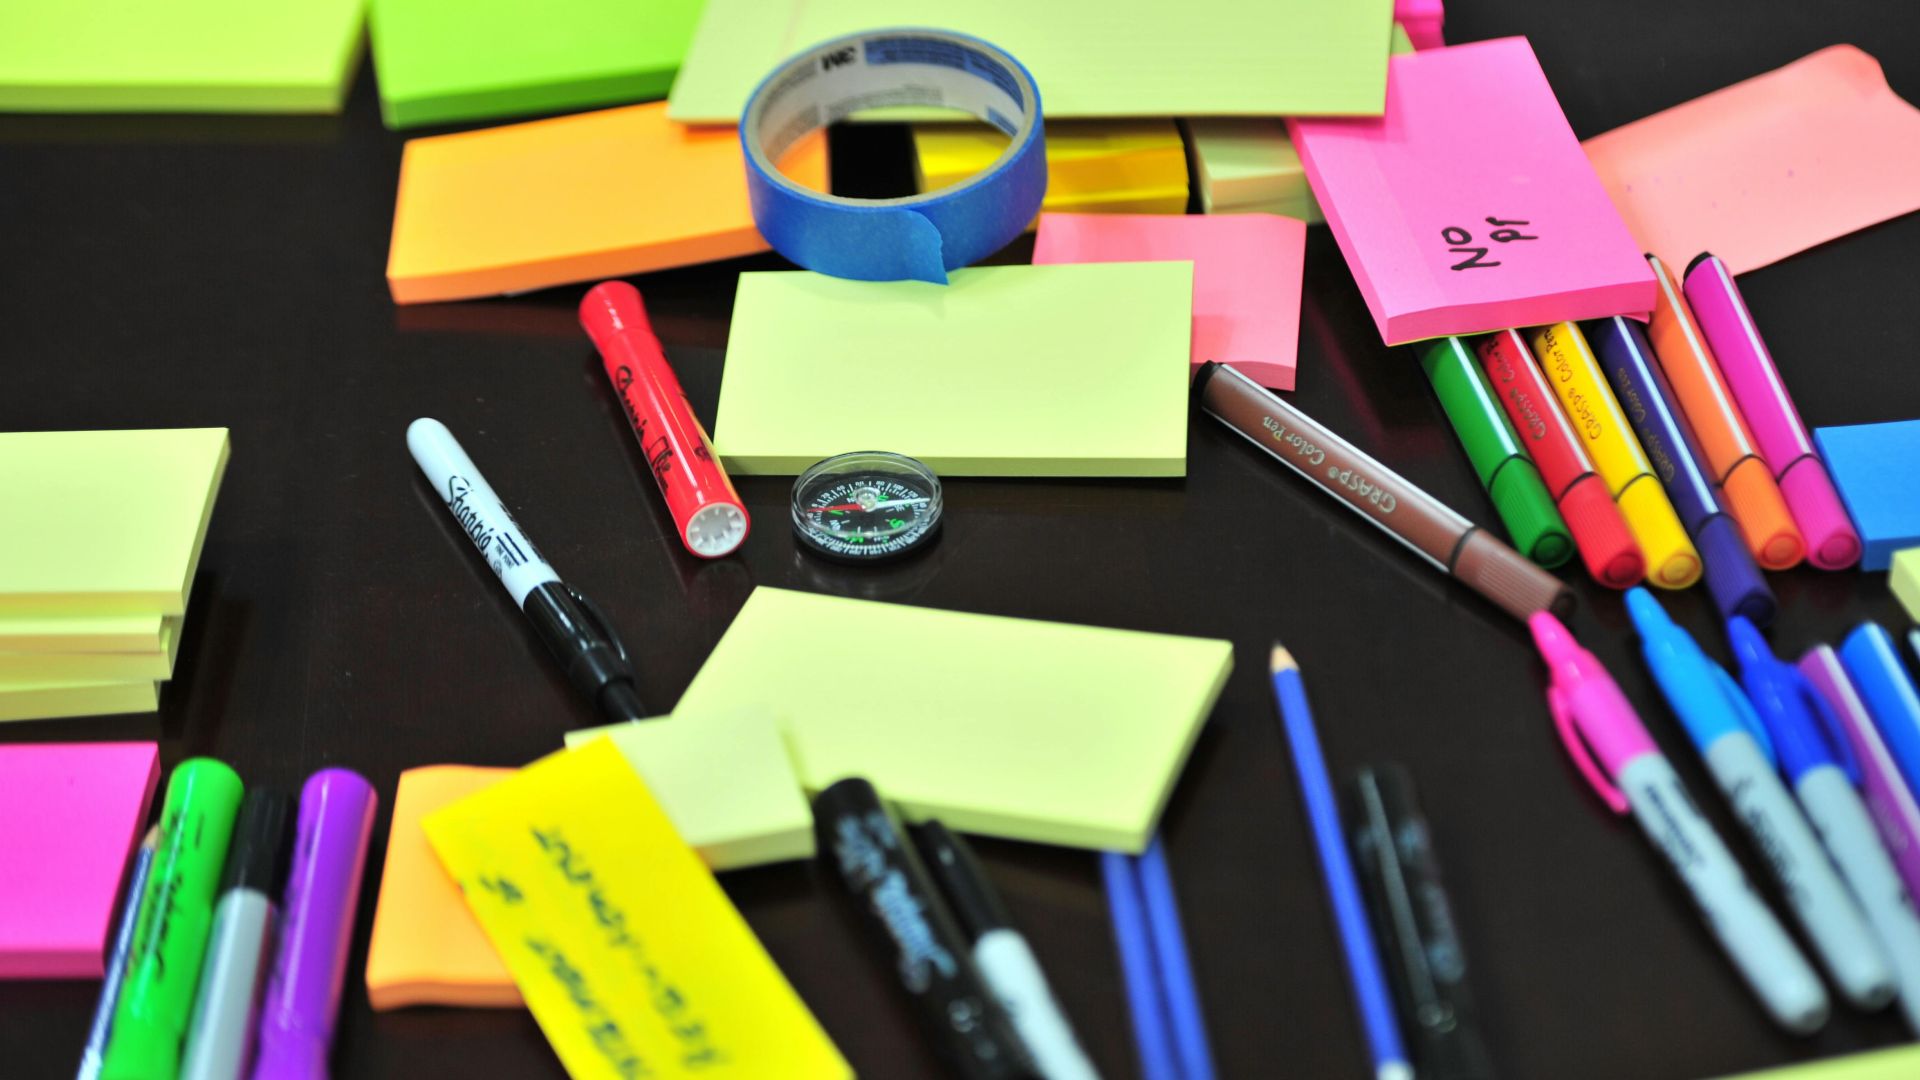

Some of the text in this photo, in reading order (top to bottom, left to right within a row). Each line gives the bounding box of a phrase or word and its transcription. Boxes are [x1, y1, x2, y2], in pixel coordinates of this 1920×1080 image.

[1441, 226, 1501, 271] NO
[1262, 415, 1287, 442] Pen
[1286, 432, 1326, 466] Color
